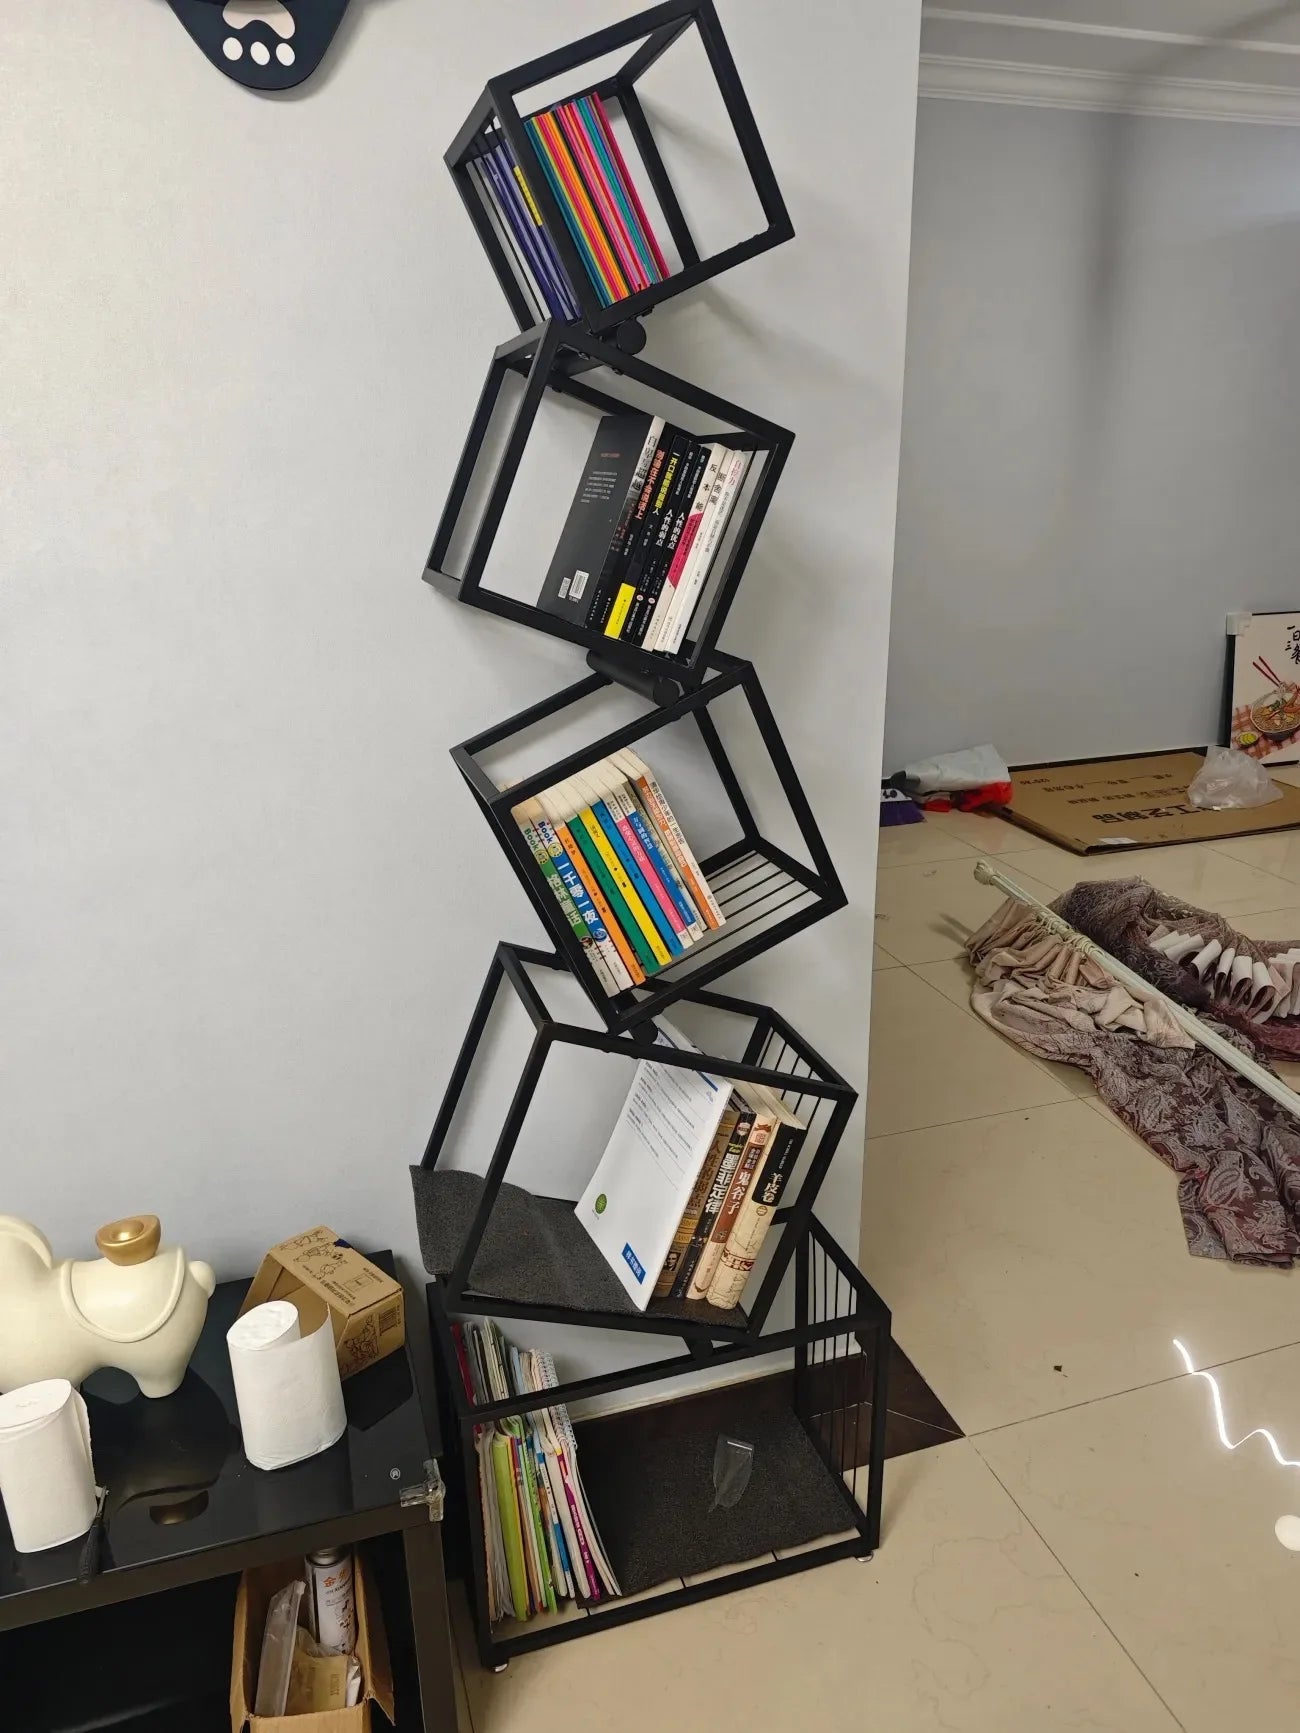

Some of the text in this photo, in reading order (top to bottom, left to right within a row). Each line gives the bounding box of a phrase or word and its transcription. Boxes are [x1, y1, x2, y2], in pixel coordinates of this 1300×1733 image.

[695, 463, 717, 512] 反本能
[655, 508, 673, 547] 人性的弱点
[667, 511, 685, 550] 人性的优点
[538, 821, 553, 844] Book
[1089, 805, 1220, 824] 工艺制品
[523, 828, 539, 850] Book
[547, 874, 582, 927] 格林童话
[557, 862, 600, 923] 一千零一夜
[705, 1153, 741, 1214] 墨菲定律
[727, 1171, 750, 1215] 鬼谷子
[761, 1172, 784, 1203] 羊皮卷
